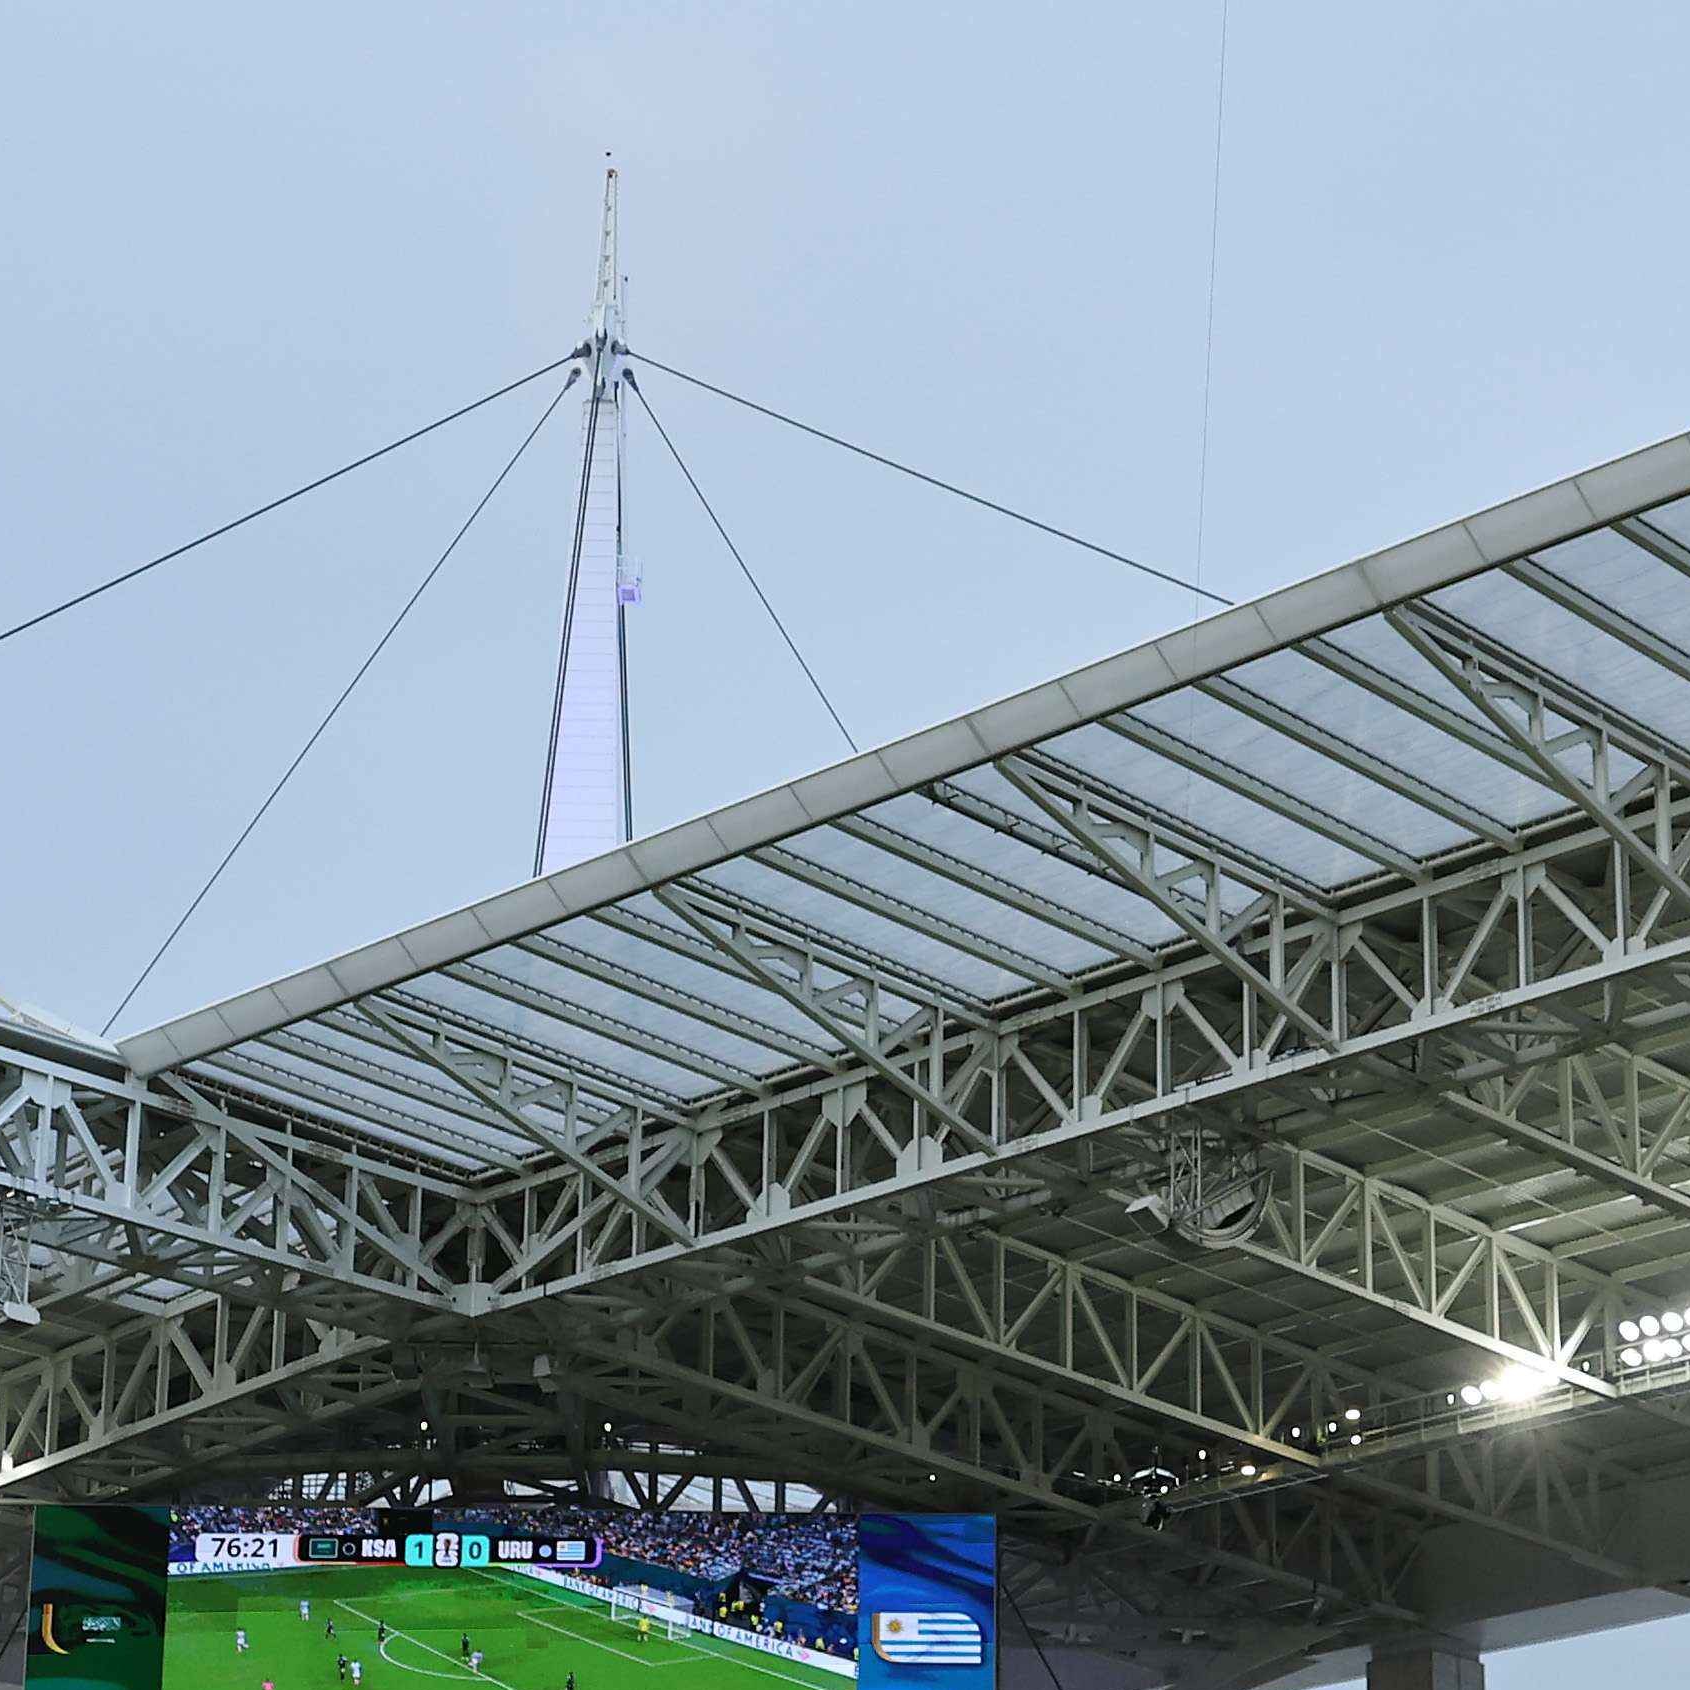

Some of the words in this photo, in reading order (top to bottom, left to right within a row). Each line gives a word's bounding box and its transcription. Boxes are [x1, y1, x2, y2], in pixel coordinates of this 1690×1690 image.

[211, 1537, 279, 1558] 76:21
[361, 1538, 397, 1558] KSA
[414, 1542, 424, 1559] 1
[470, 1543, 480, 1560] 0
[499, 1540, 533, 1558] URU
